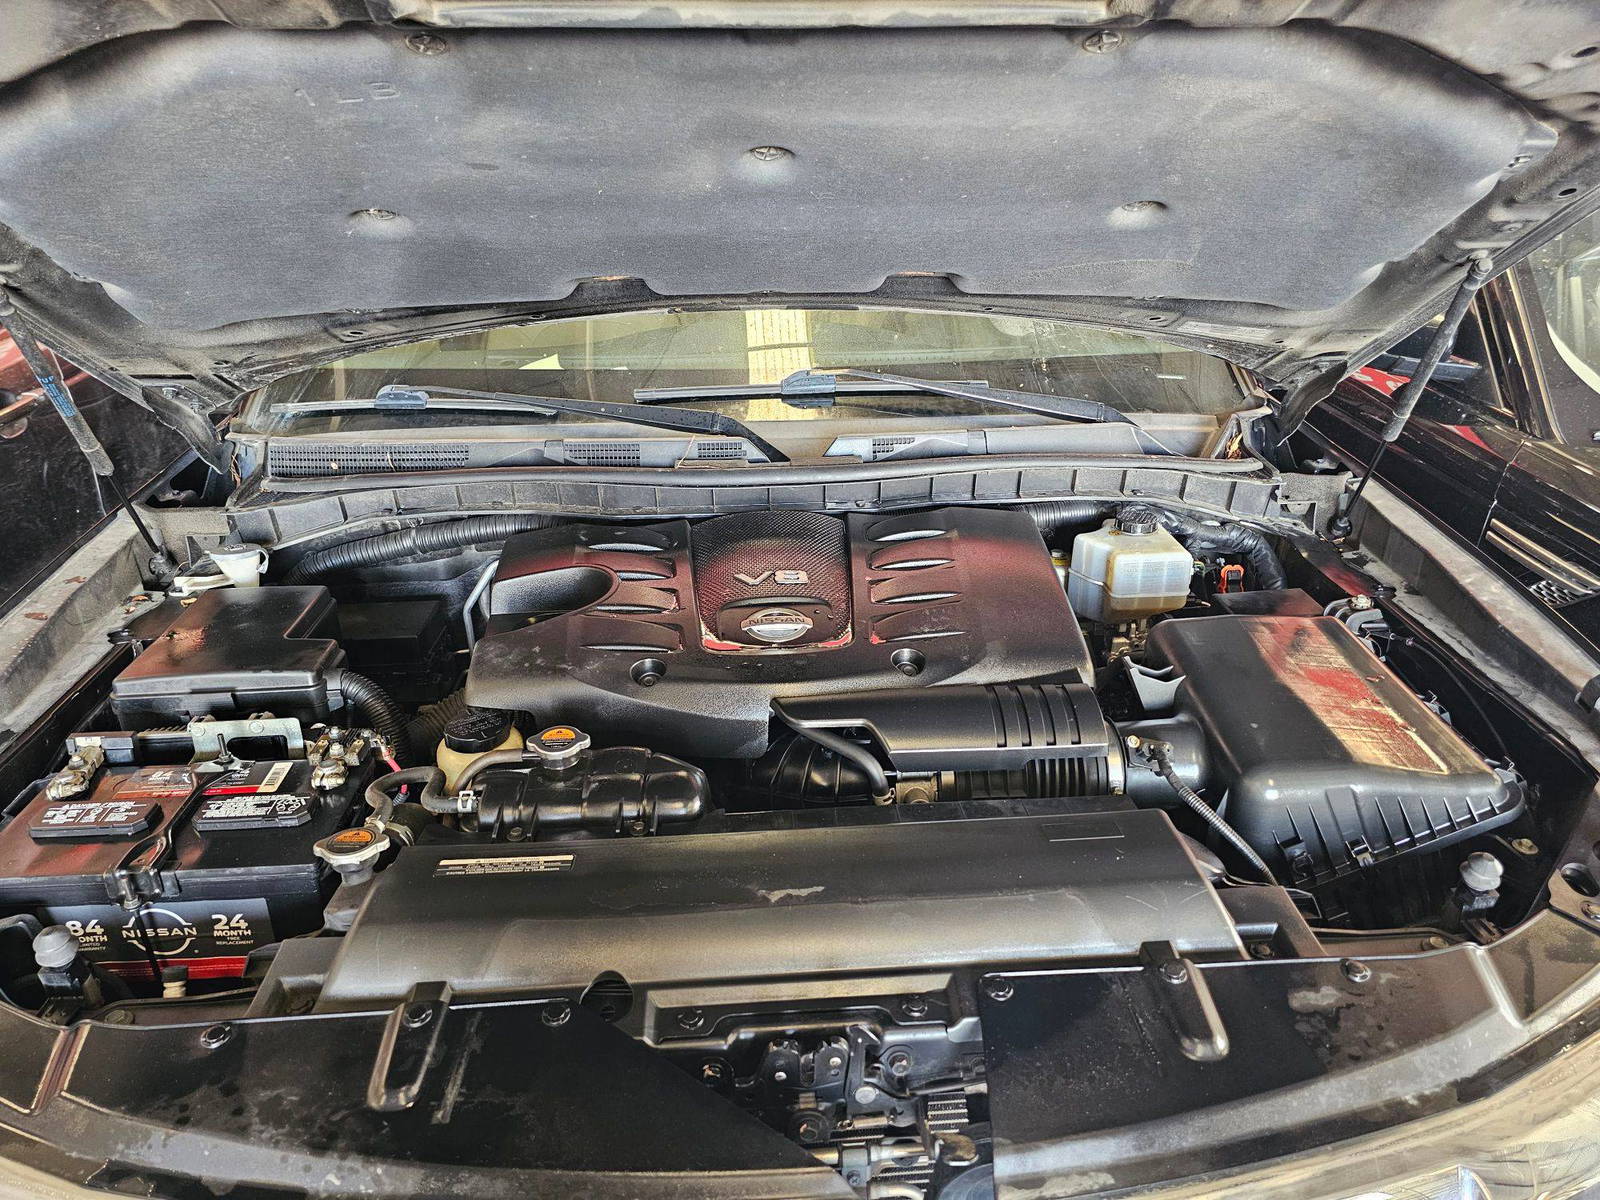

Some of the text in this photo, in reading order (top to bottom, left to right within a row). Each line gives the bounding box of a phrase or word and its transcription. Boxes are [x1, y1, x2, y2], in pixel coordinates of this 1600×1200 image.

[734, 569, 809, 586] V8
[748, 617, 805, 625] NISSAN
[65, 919, 105, 936] 84
[211, 913, 249, 929] 24
[78, 934, 108, 943] ONTH
[122, 926, 198, 939] NISSAN
[213, 929, 252, 937] MONTH
